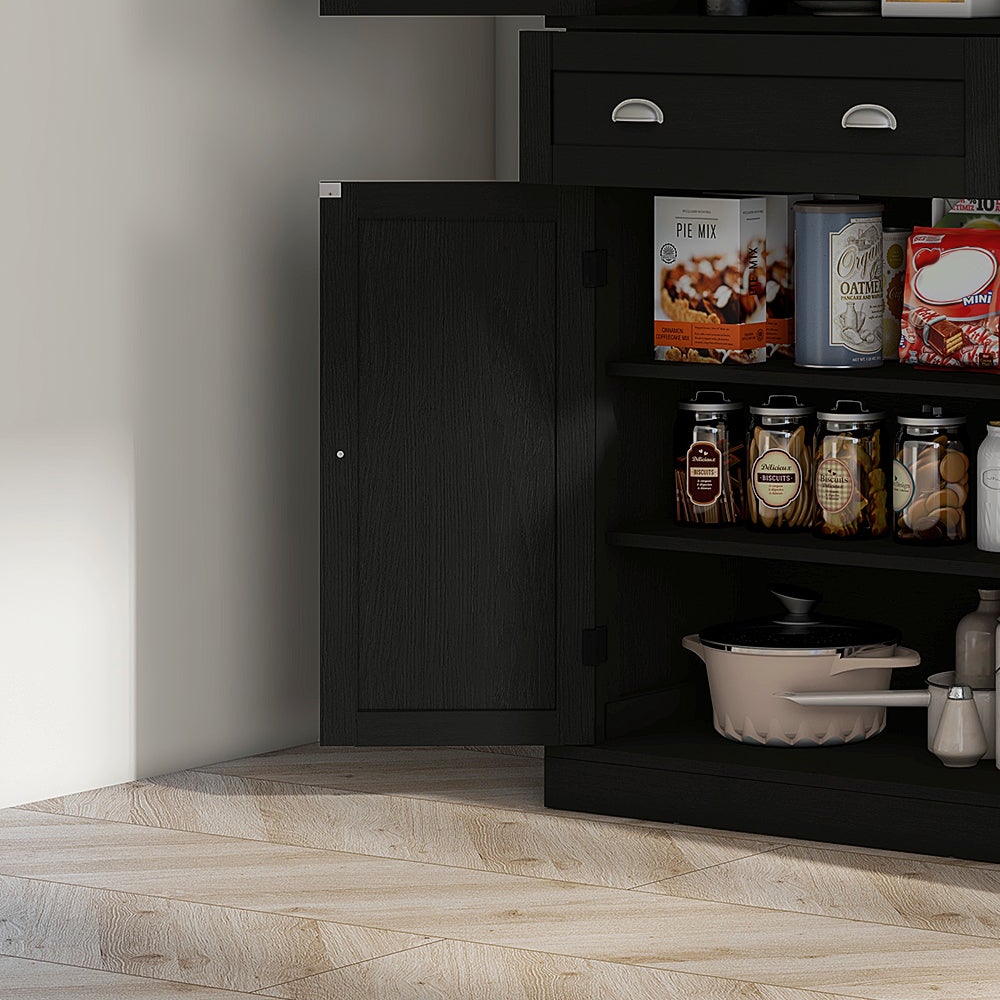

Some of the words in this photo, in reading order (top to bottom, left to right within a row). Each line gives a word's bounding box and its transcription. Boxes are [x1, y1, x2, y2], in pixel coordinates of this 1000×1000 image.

[676, 222, 693, 238] PIE
[698, 223, 717, 239] MIX
[748, 247, 758, 270] MIX
[820, 474, 848, 484] Biscuits
